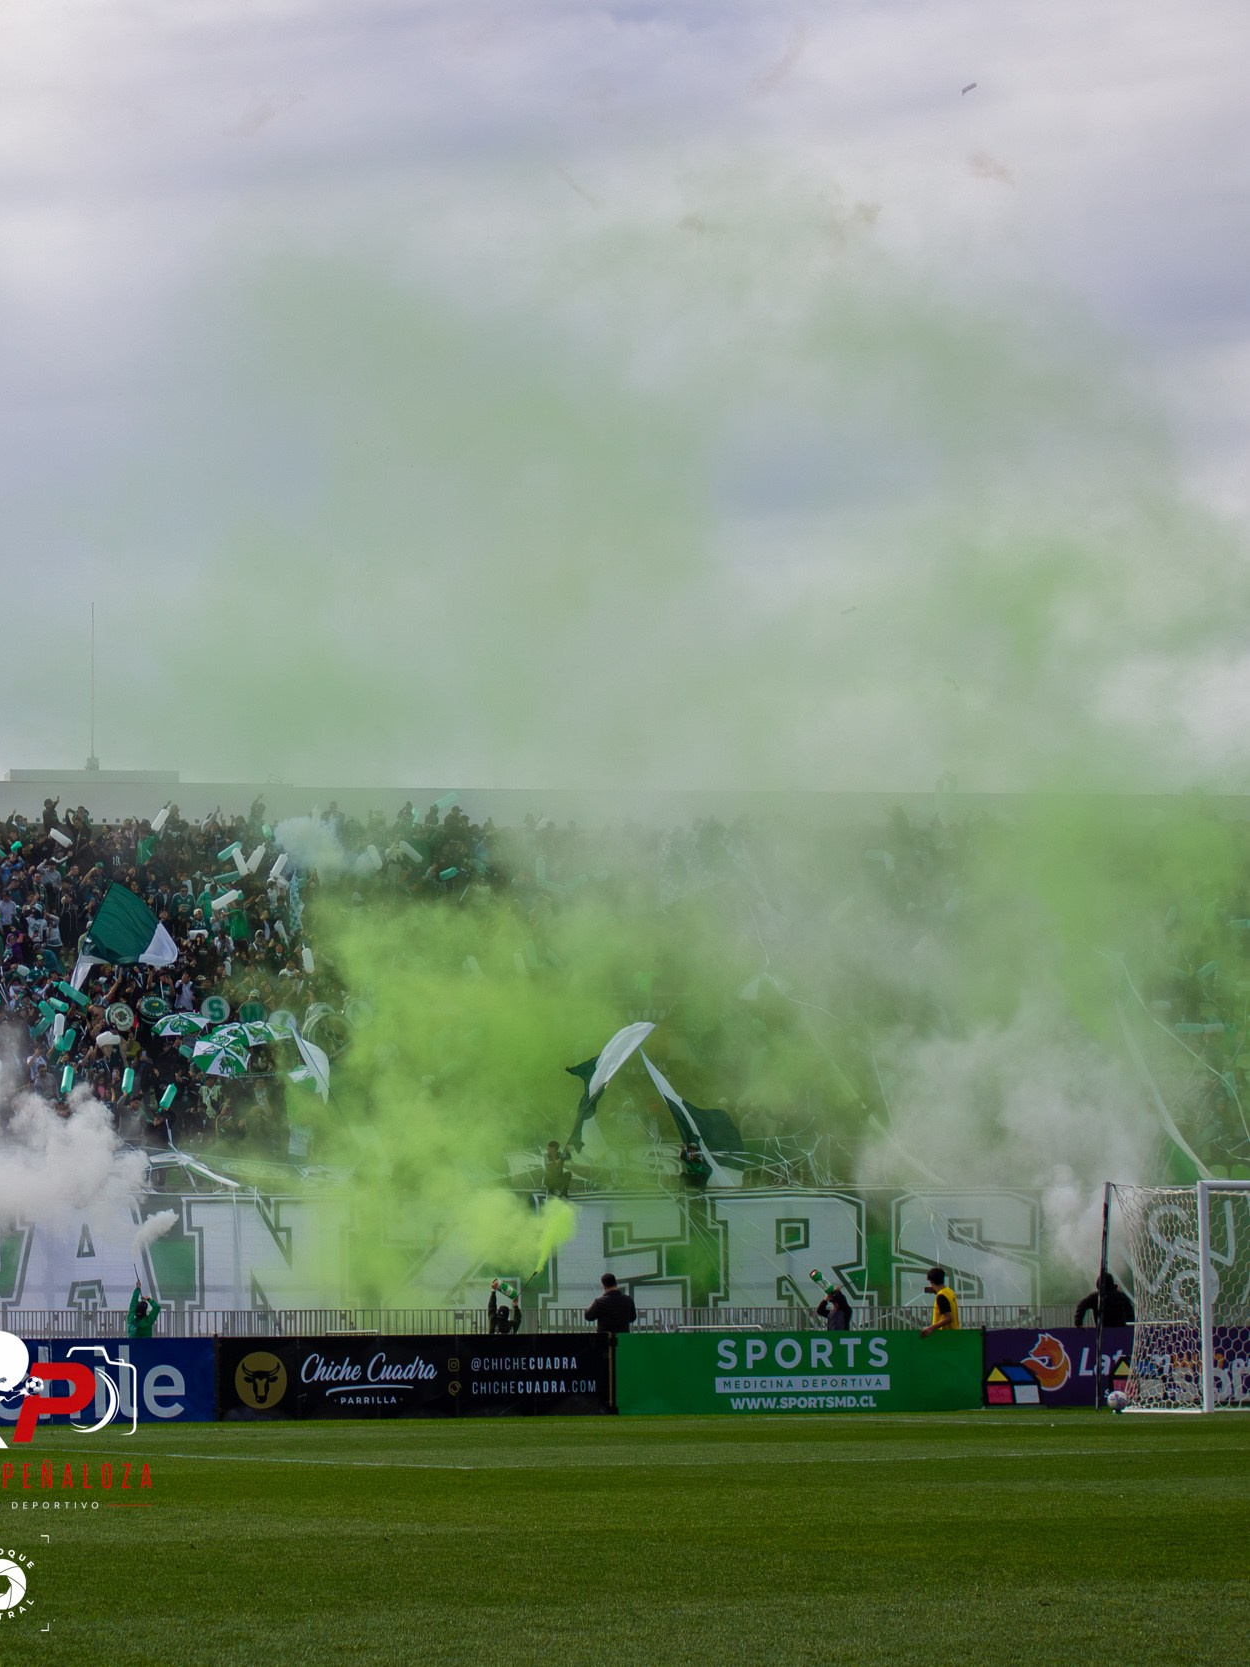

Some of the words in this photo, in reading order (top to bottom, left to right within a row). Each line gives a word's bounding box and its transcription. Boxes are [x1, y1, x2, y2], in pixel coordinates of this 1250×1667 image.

[717, 1337, 889, 1370] SPORTS
[301, 1353, 361, 1383] Chiche
[367, 1353, 437, 1382] Cuadra
[471, 1356, 578, 1372] @CHICHECUADRA
[472, 1379, 596, 1395] CHICHECUADRA.COM
[723, 1379, 794, 1389] MEDICINA
[801, 1377, 883, 1388] DEPORTIVA
[340, 1396, 397, 1405] PARRILLA
[730, 1395, 877, 1410] WWW.SPORTSMD.CL
